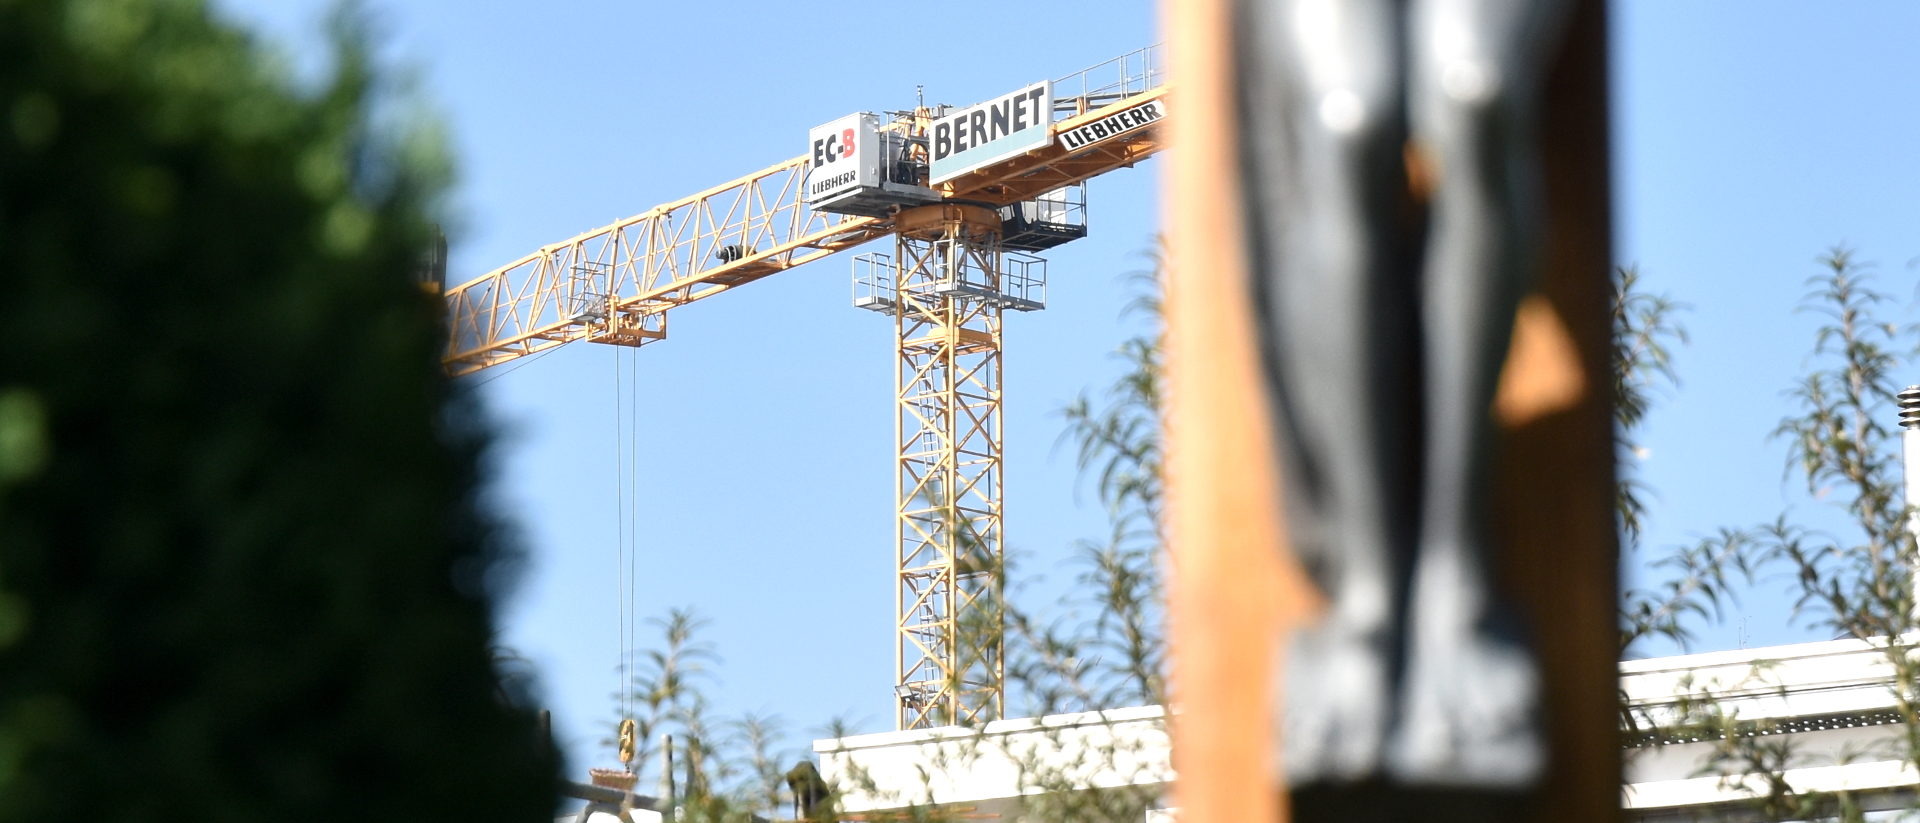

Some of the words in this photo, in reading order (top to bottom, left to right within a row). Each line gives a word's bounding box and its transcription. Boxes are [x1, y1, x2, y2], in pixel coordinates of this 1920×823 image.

[934, 86, 1044, 161] BERNET
[1063, 102, 1162, 149] LIEBHERR
[813, 128, 855, 168] EC-B
[812, 169, 856, 195] LIEBHERR
